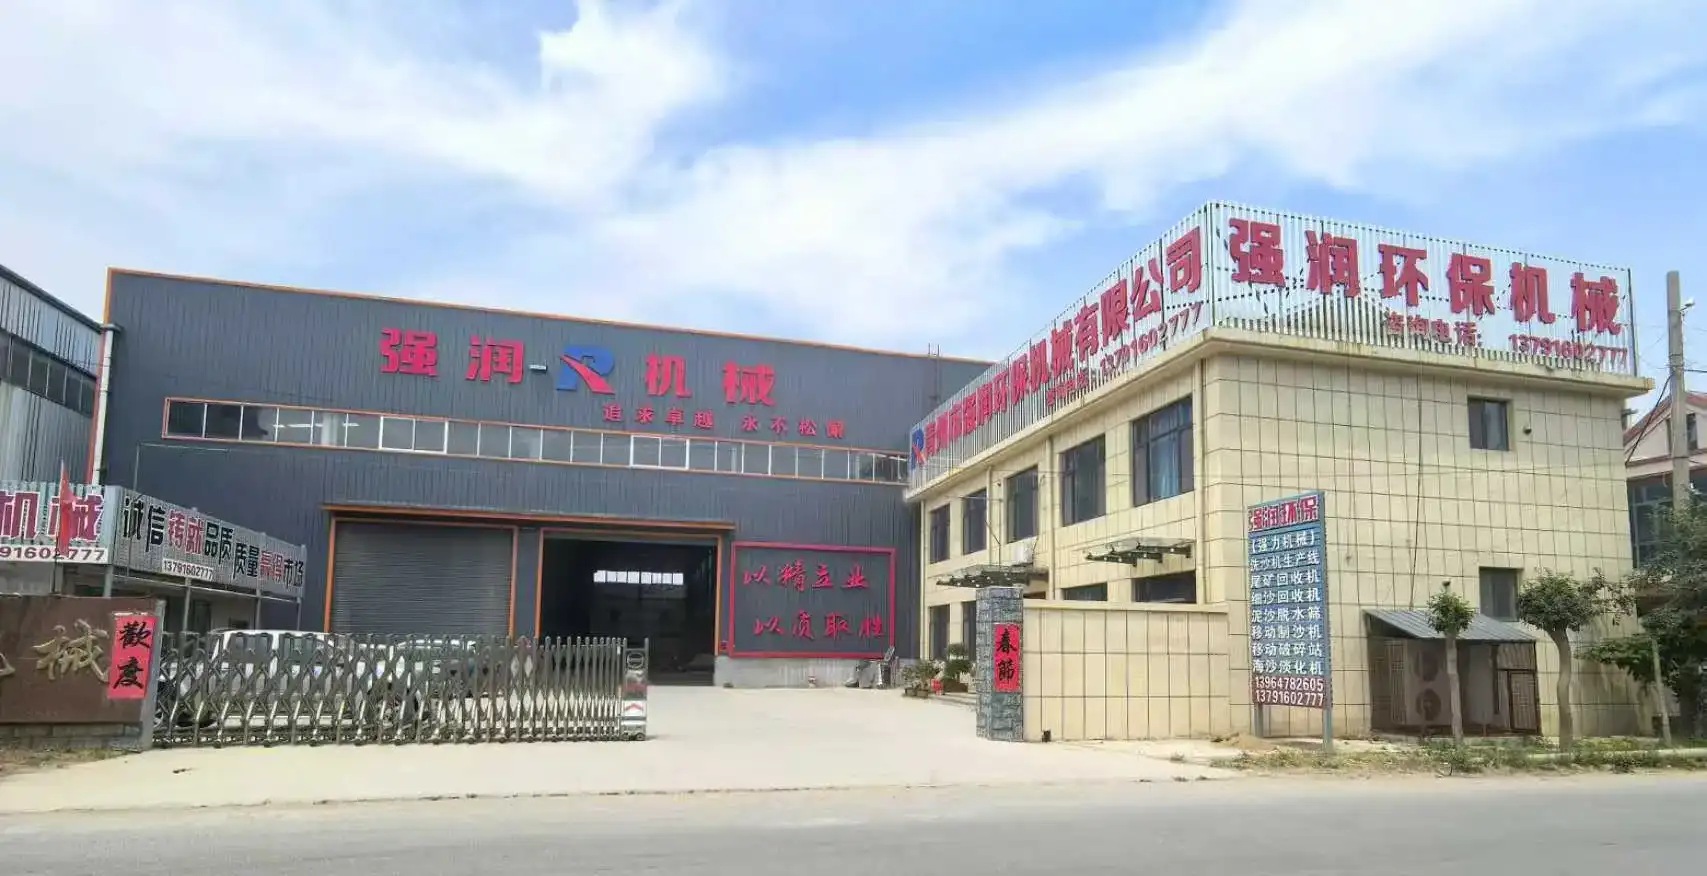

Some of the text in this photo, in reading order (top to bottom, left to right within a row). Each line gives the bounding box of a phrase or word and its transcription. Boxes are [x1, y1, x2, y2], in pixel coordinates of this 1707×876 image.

[1229, 217, 1622, 336] 强润环保机械
[602, 403, 715, 429] 追求卓越
[1248, 496, 1319, 532] 强润环保
[163, 559, 213, 579] 13791602777
[743, 558, 870, 592] 以精立业
[753, 610, 885, 641] 以质取胜
[1252, 624, 1322, 640] 移动制沙机
[1252, 642, 1323, 657] 移动破碎站
[1255, 676, 1324, 692] 13964782605
[1255, 689, 1324, 706] 13791602777
